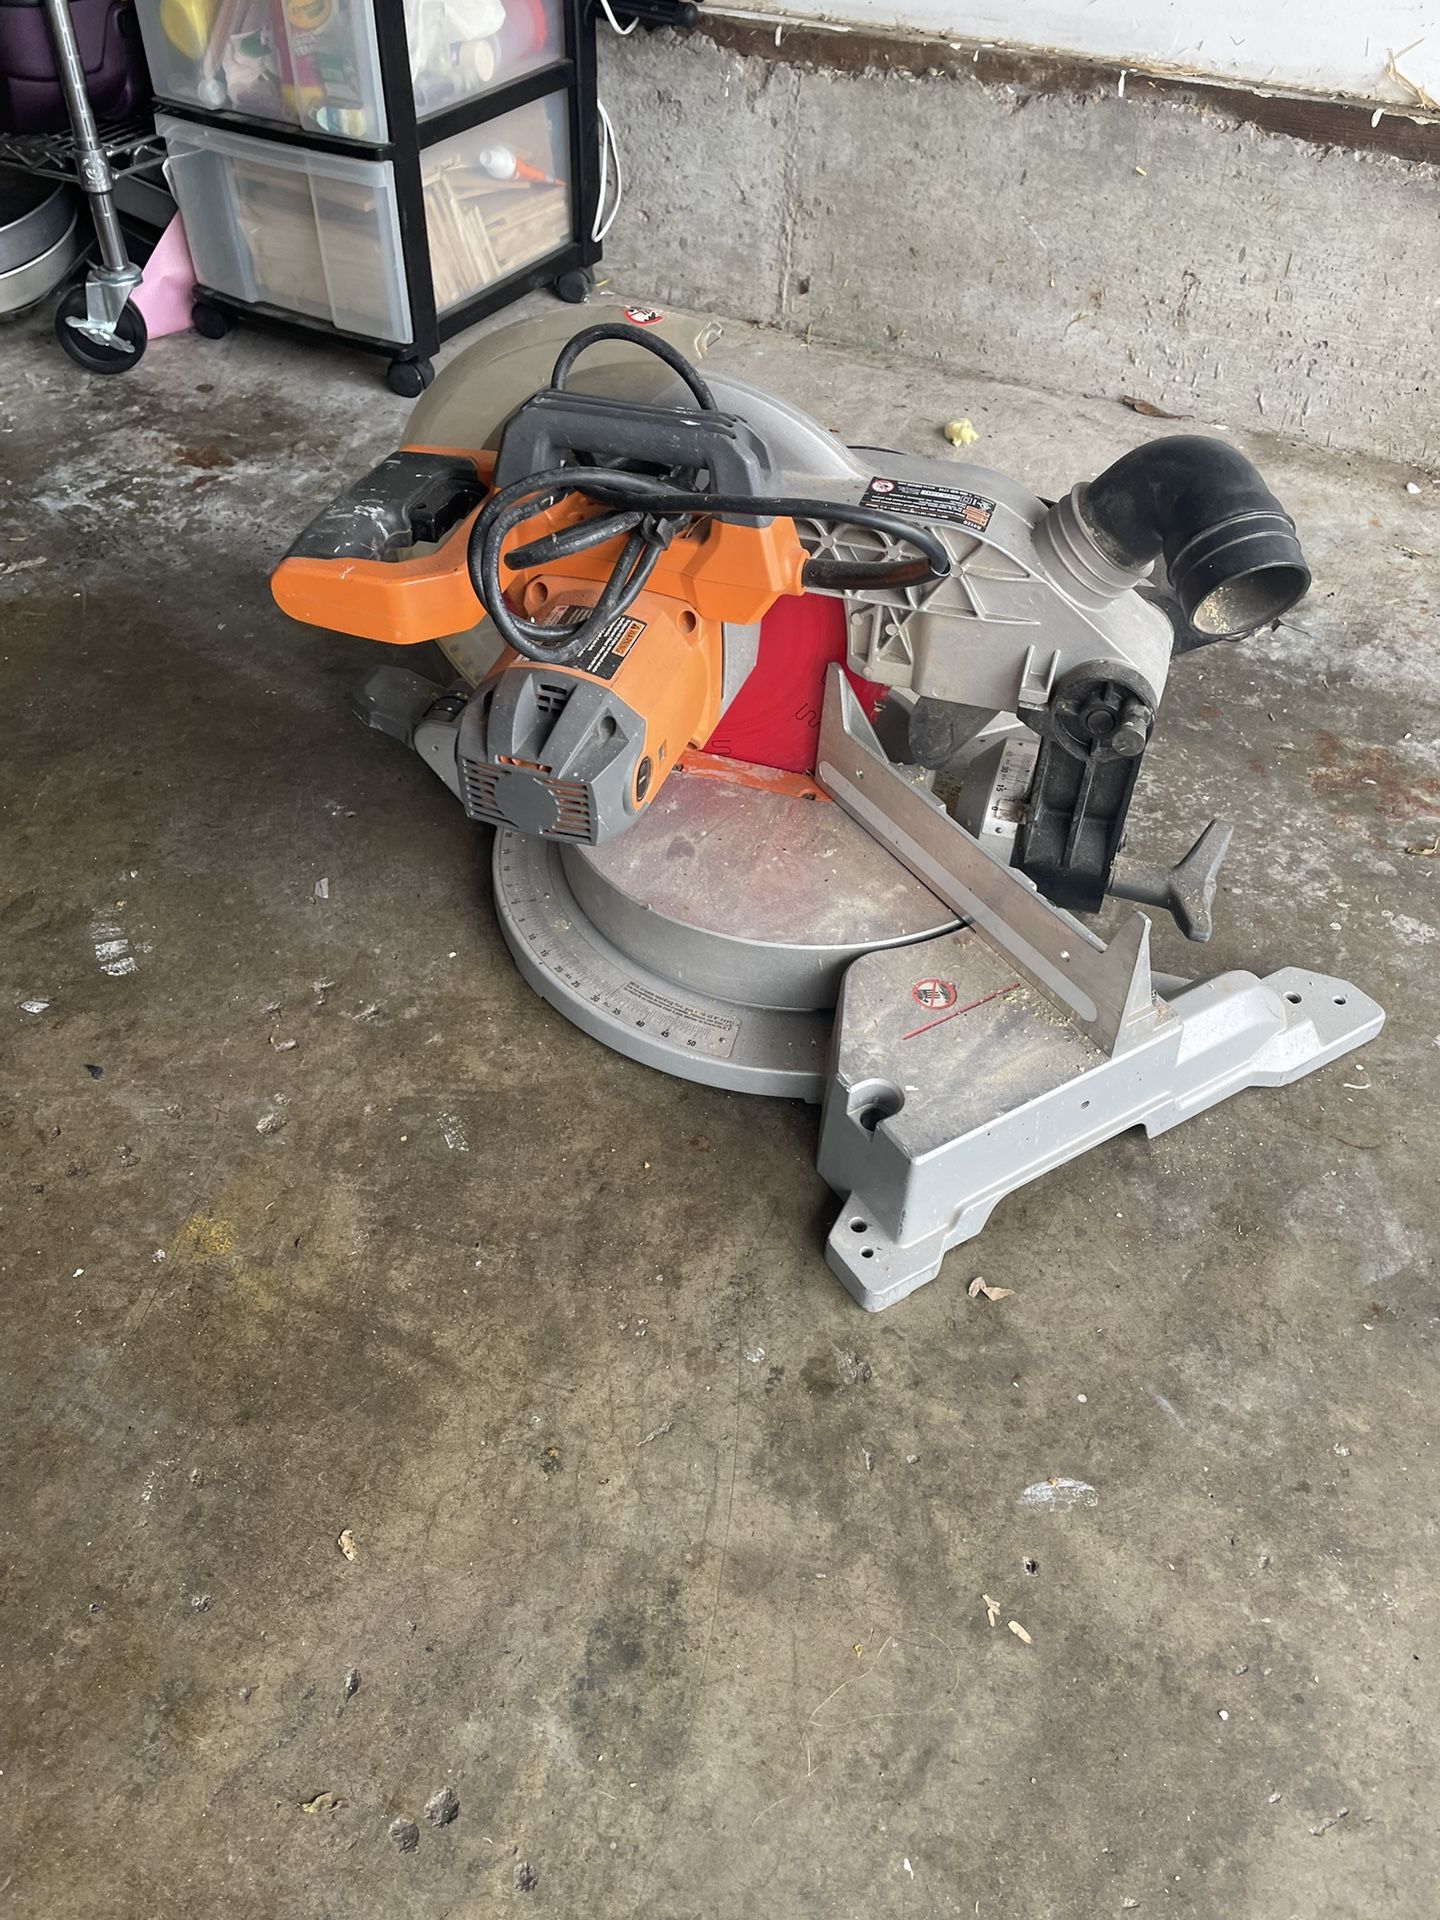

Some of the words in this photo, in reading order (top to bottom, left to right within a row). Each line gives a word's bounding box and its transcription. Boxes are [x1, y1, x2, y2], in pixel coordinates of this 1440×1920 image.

[996, 784, 1005, 792] 15
[540, 949, 549, 957] 15
[554, 965, 564, 973] 20
[571, 980, 581, 988] 25
[590, 994, 600, 1002] 30
[611, 1007, 621, 1015] 35
[635, 1020, 645, 1028] 40
[660, 1030, 669, 1038] 45
[686, 1039, 697, 1047] 50
